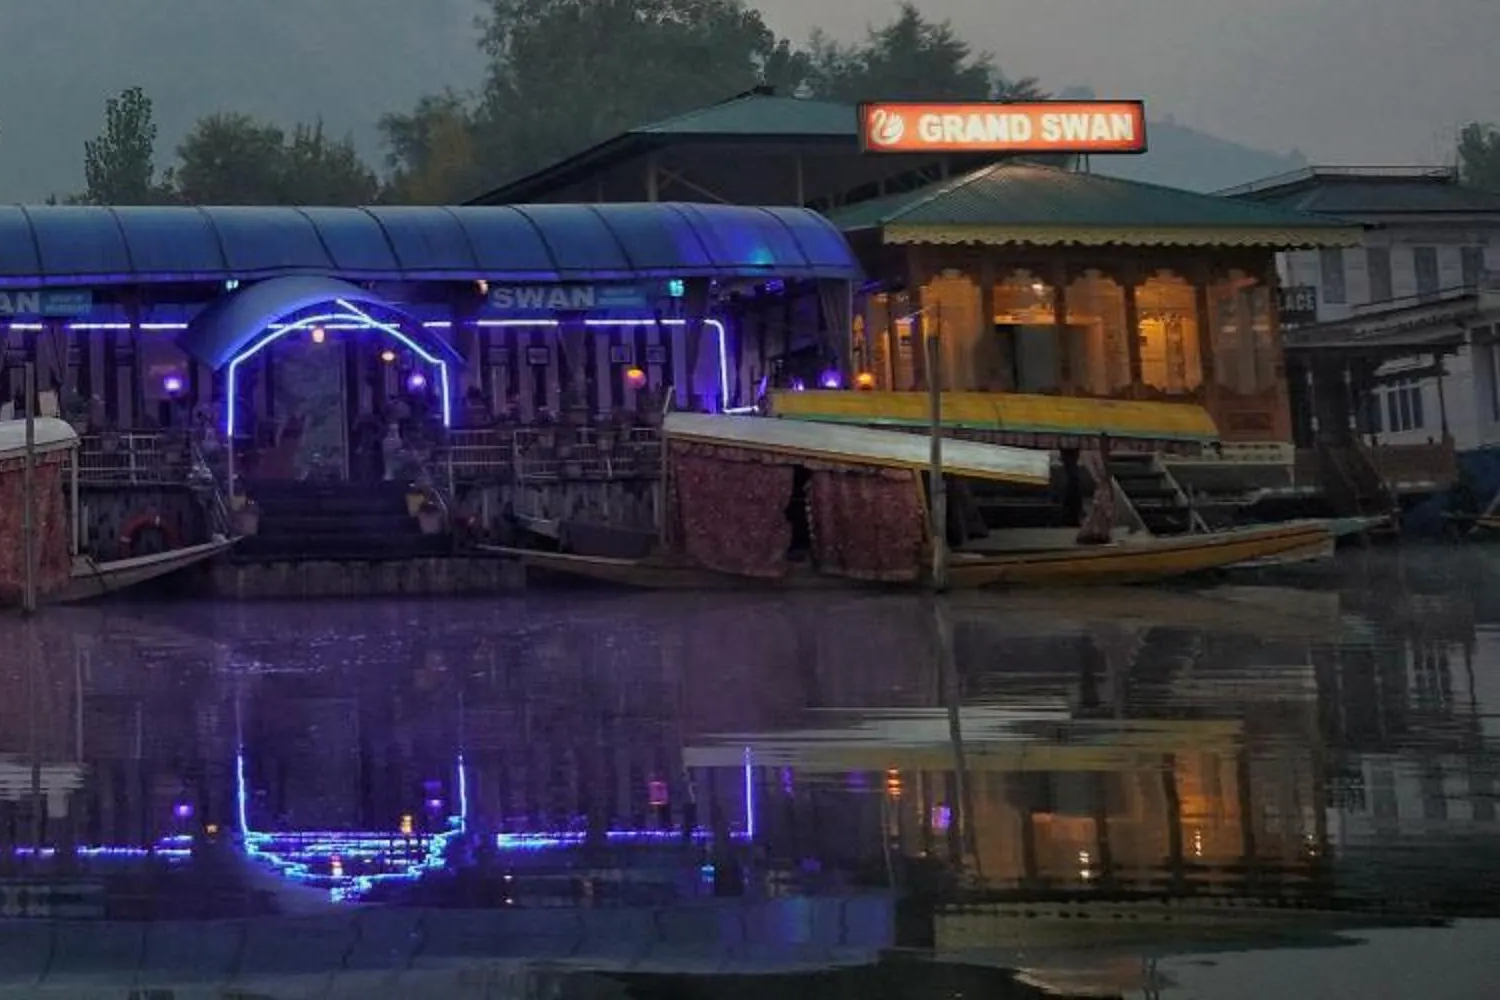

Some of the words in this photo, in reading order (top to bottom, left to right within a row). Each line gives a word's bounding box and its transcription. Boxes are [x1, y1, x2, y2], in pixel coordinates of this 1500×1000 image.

[918, 113, 1032, 142] GRAND
[1040, 114, 1133, 141] SWAN
[493, 287, 595, 309] SWAN
